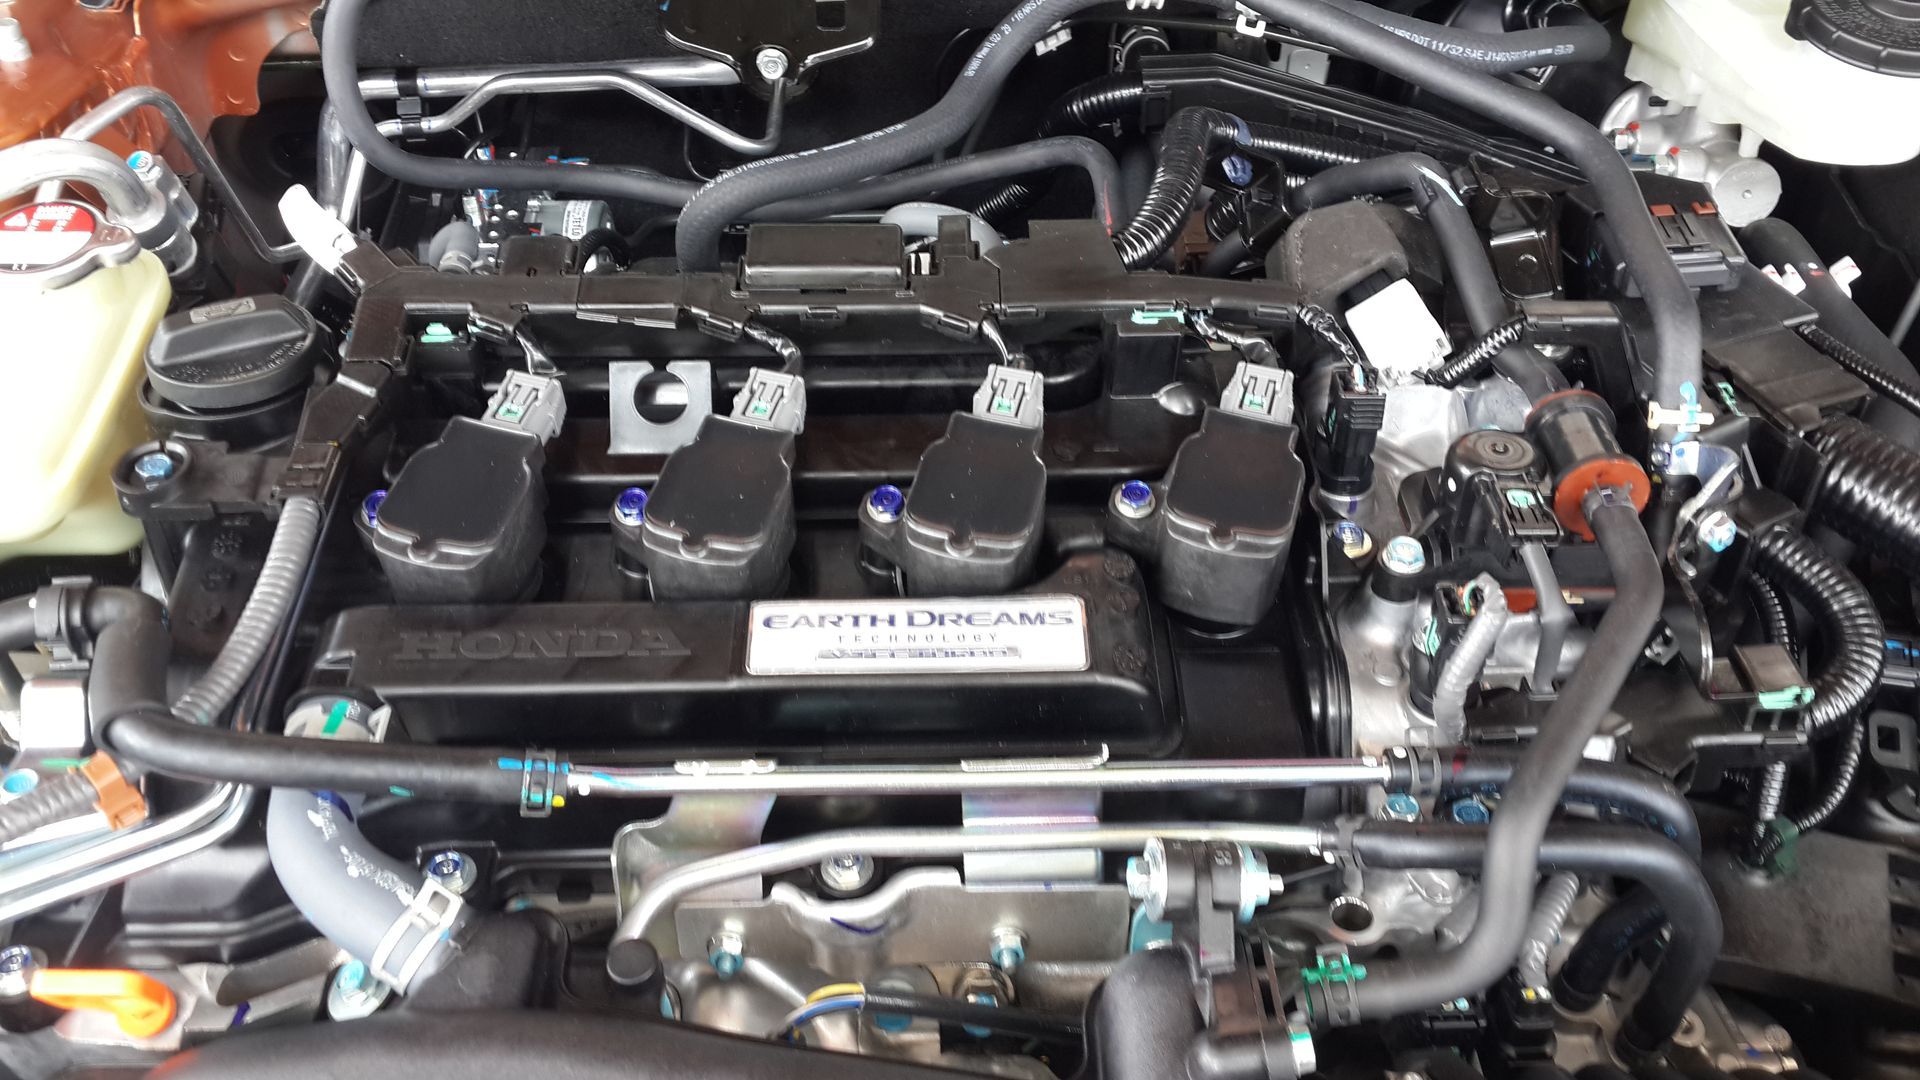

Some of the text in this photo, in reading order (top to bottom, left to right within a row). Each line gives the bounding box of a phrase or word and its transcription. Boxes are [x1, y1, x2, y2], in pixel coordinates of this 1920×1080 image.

[762, 610, 1074, 629] EARTH DREAMS
[393, 629, 691, 659] HONDA
[838, 633, 998, 644] TECHNOLOGY
